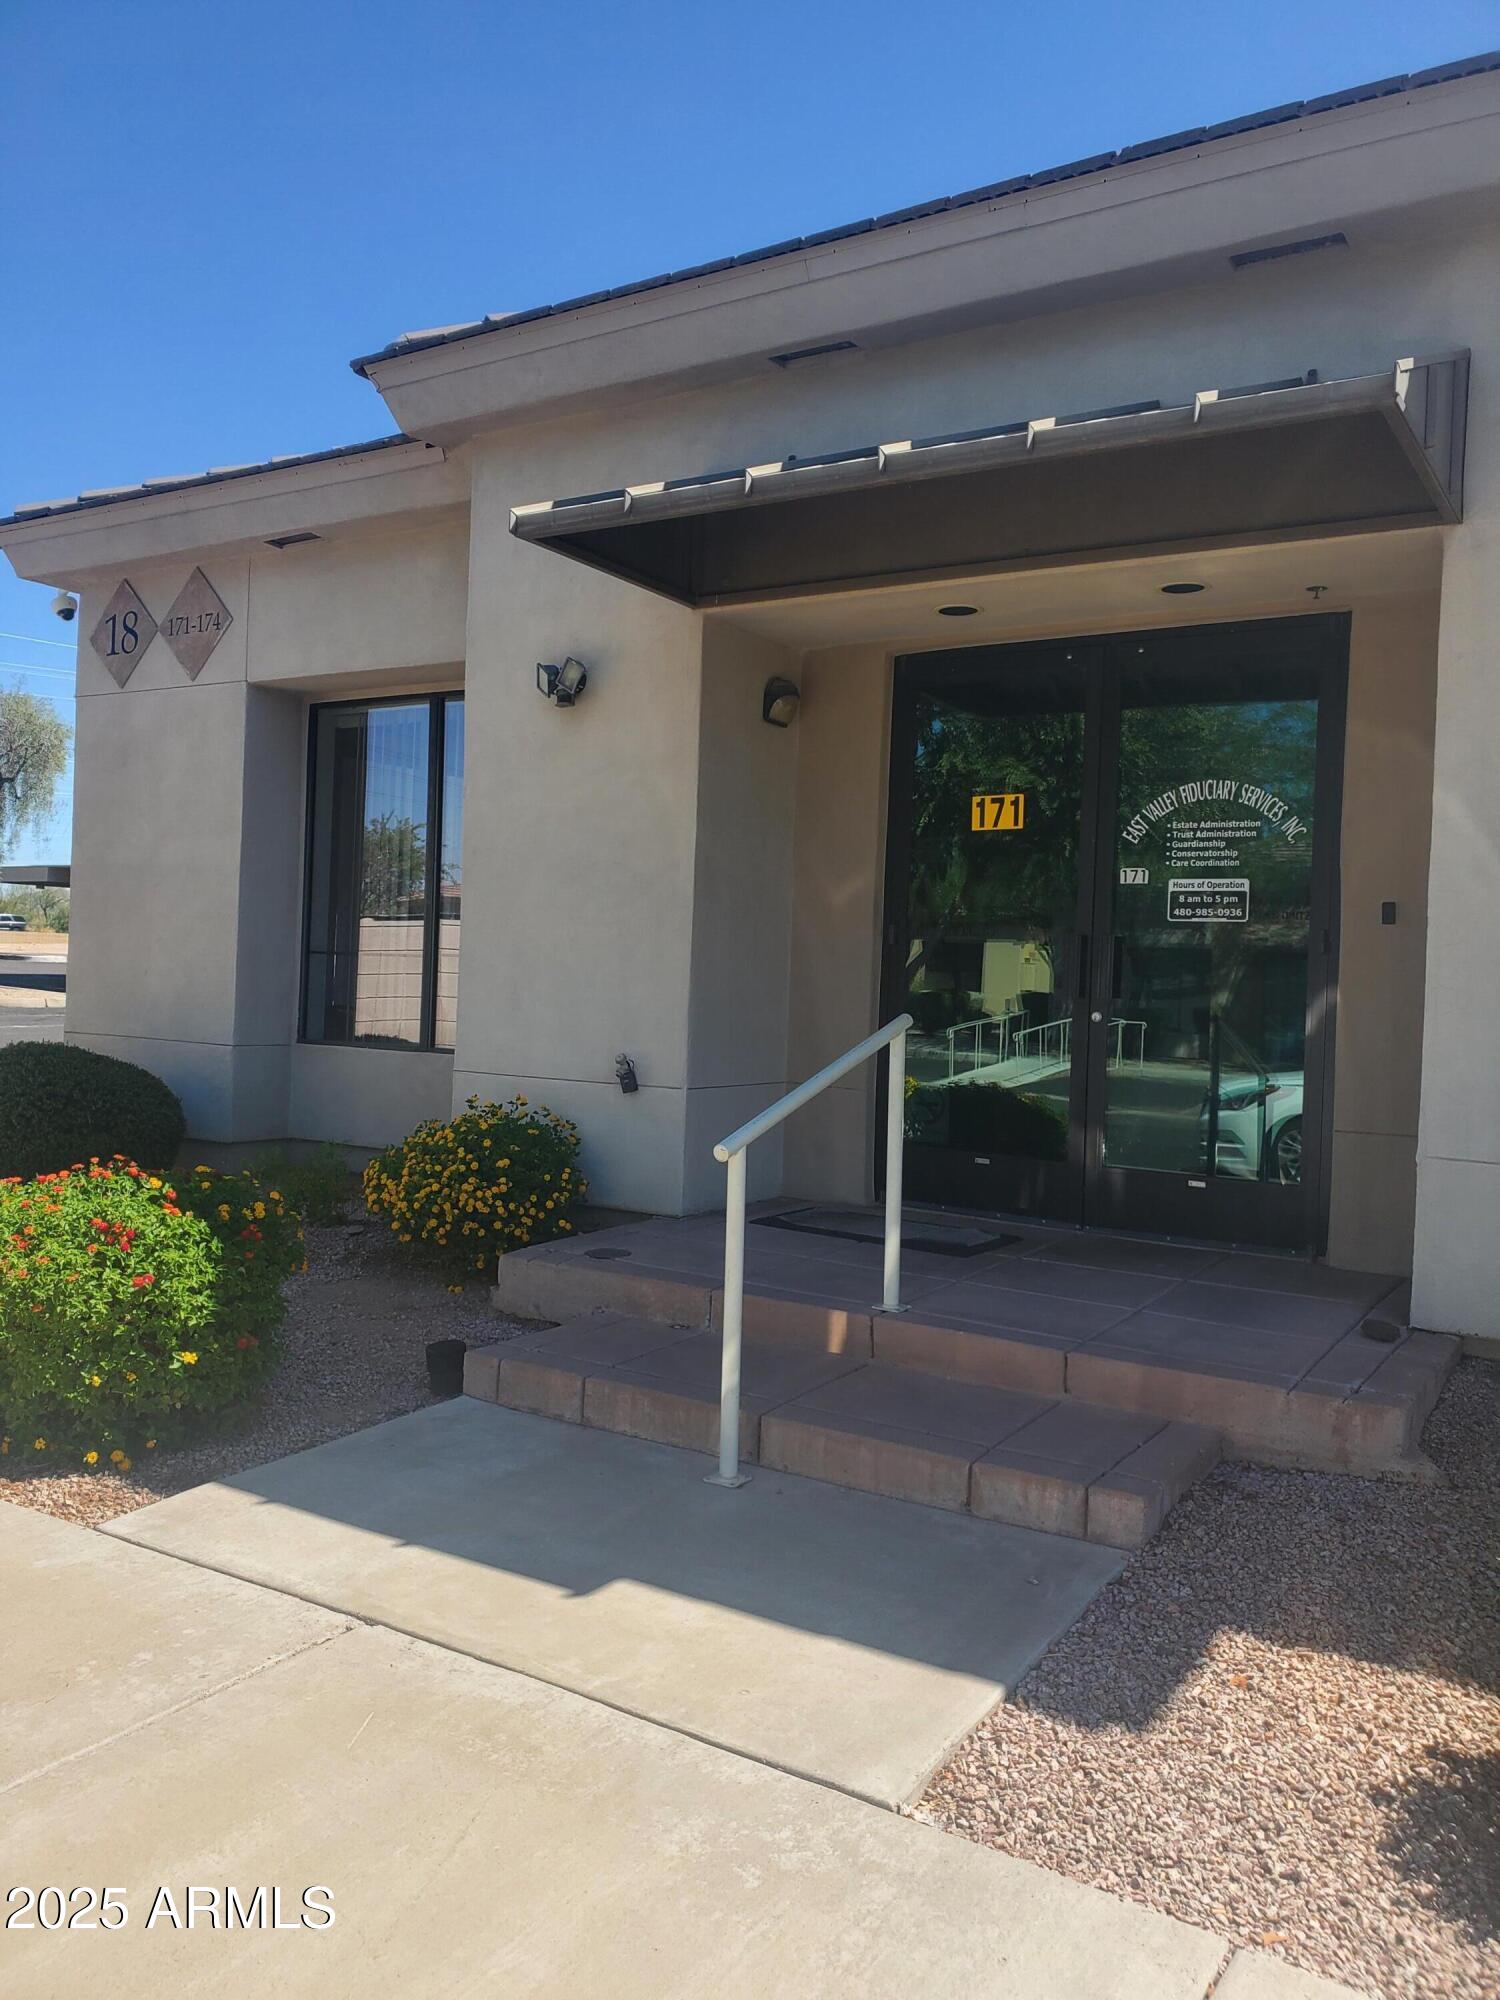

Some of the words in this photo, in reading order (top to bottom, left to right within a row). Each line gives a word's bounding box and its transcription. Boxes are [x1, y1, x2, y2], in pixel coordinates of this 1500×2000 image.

[167, 611, 221, 637] 171-174
[105, 610, 139, 656] 18
[976, 796, 1020, 828] 171
[1122, 815, 1150, 845] EAST
[1142, 789, 1179, 823] VALLEY
[1179, 779, 1240, 805] FIDUCIARY
[1239, 783, 1289, 828] SERVICES,
[1172, 821, 1199, 829] Estate
[1199, 819, 1261, 829] Administration
[1172, 831, 1195, 839] Trust
[1195, 829, 1257, 838] Administration
[1172, 840, 1226, 848] Guardianship
[1171, 849, 1238, 858] Conservatorship
[1190, 859, 1240, 867] Coordination
[1121, 869, 1147, 883] 171
[1172, 881, 1195, 889] Hours
[1197, 881, 1205, 889] of
[1207, 881, 1245, 890] Operation
[1179, 895, 1185, 903] 8
[1215, 895, 1221, 903] 5
[1223, 896, 1239, 905] pm
[1173, 908, 1243, 917] 480-985-0936
